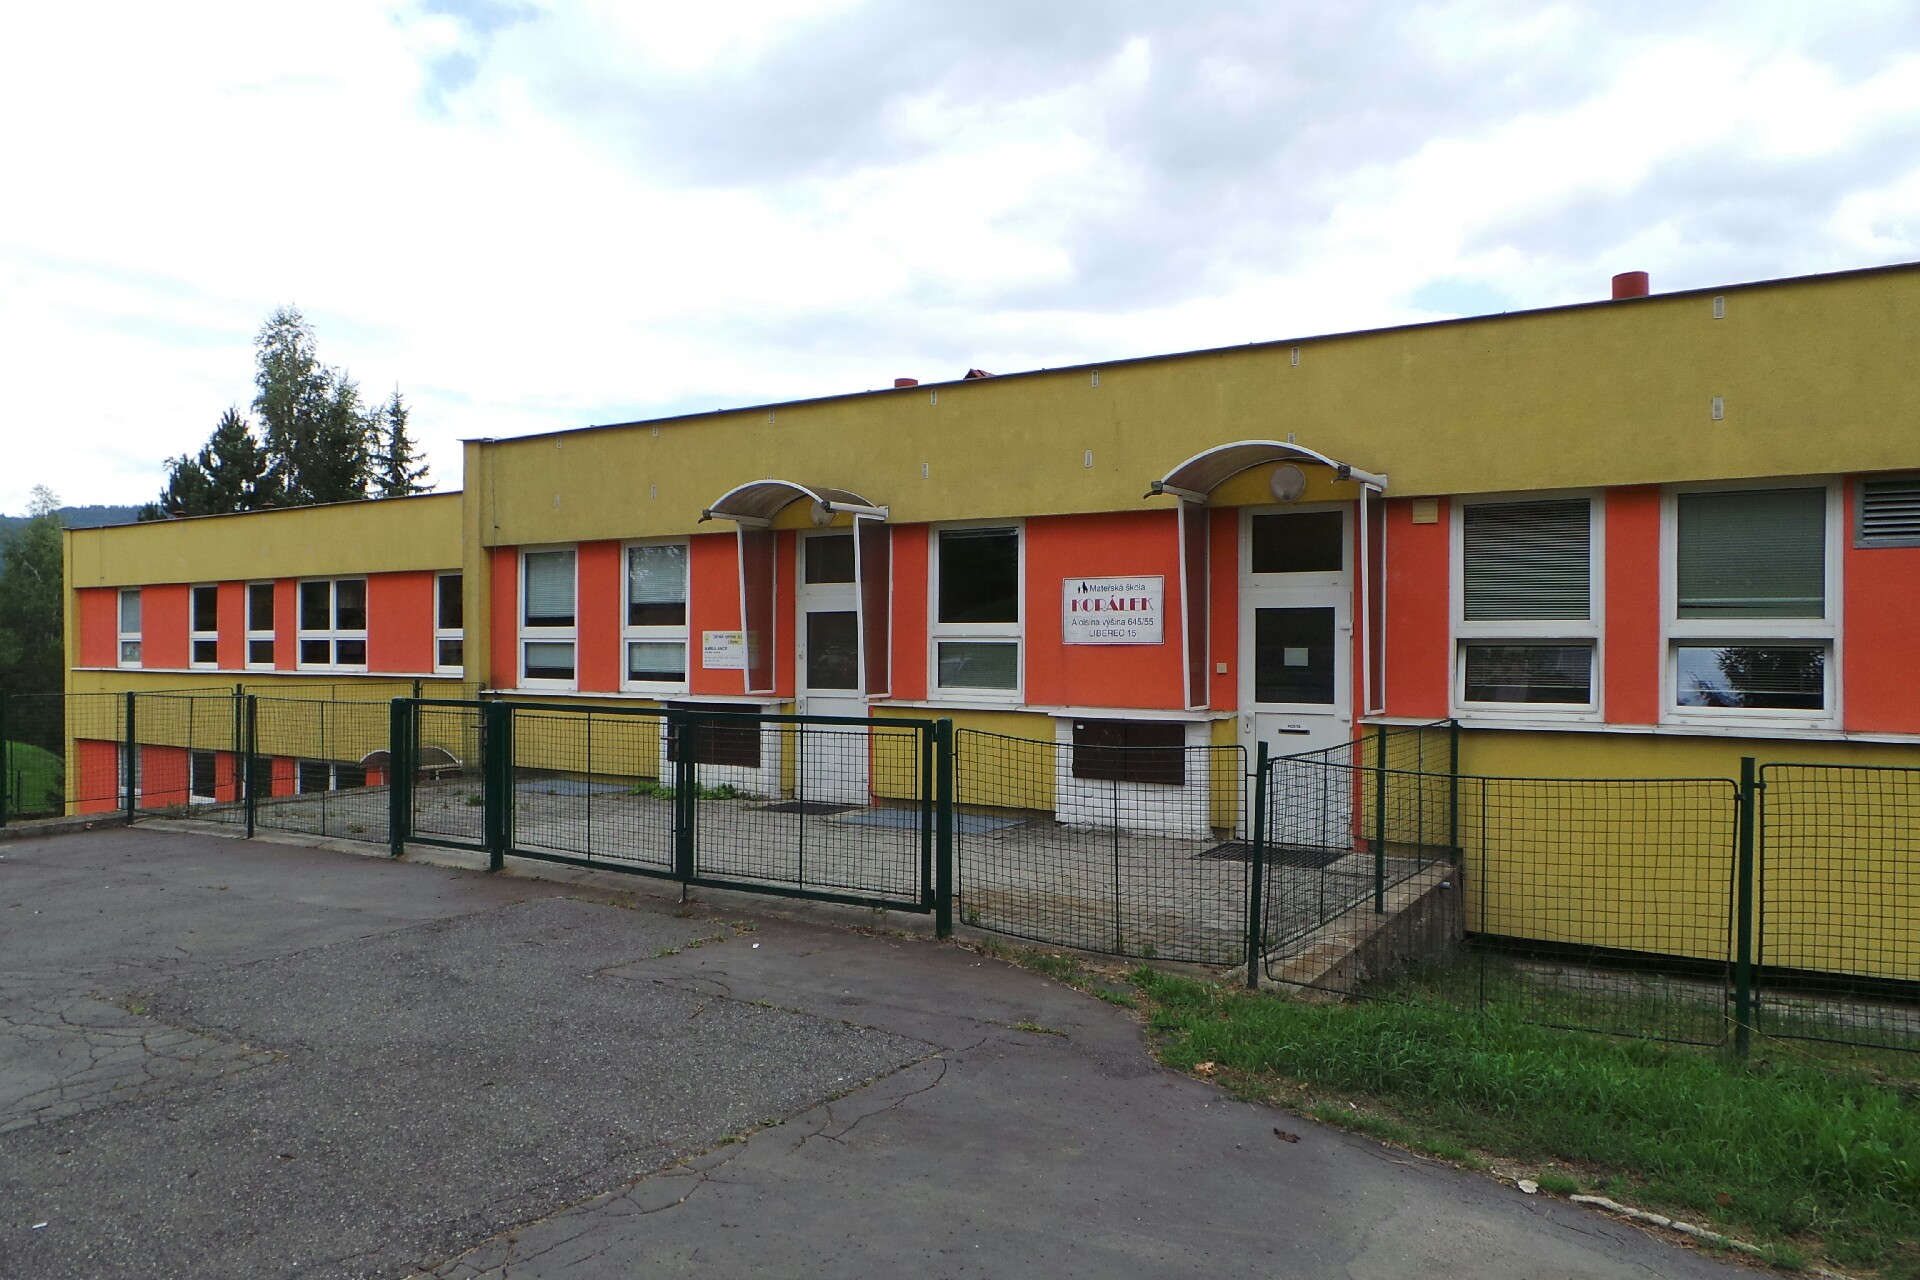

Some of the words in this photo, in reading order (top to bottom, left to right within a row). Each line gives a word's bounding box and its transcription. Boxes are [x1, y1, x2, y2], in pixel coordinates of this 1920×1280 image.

[1089, 584, 1124, 592] Mateřská
[1125, 583, 1146, 592] škola
[1071, 594, 1154, 612] KORÁLEK
[1102, 617, 1126, 628] výšina
[1127, 617, 1154, 626] 645/55
[1089, 629, 1125, 637] LIBEREC
